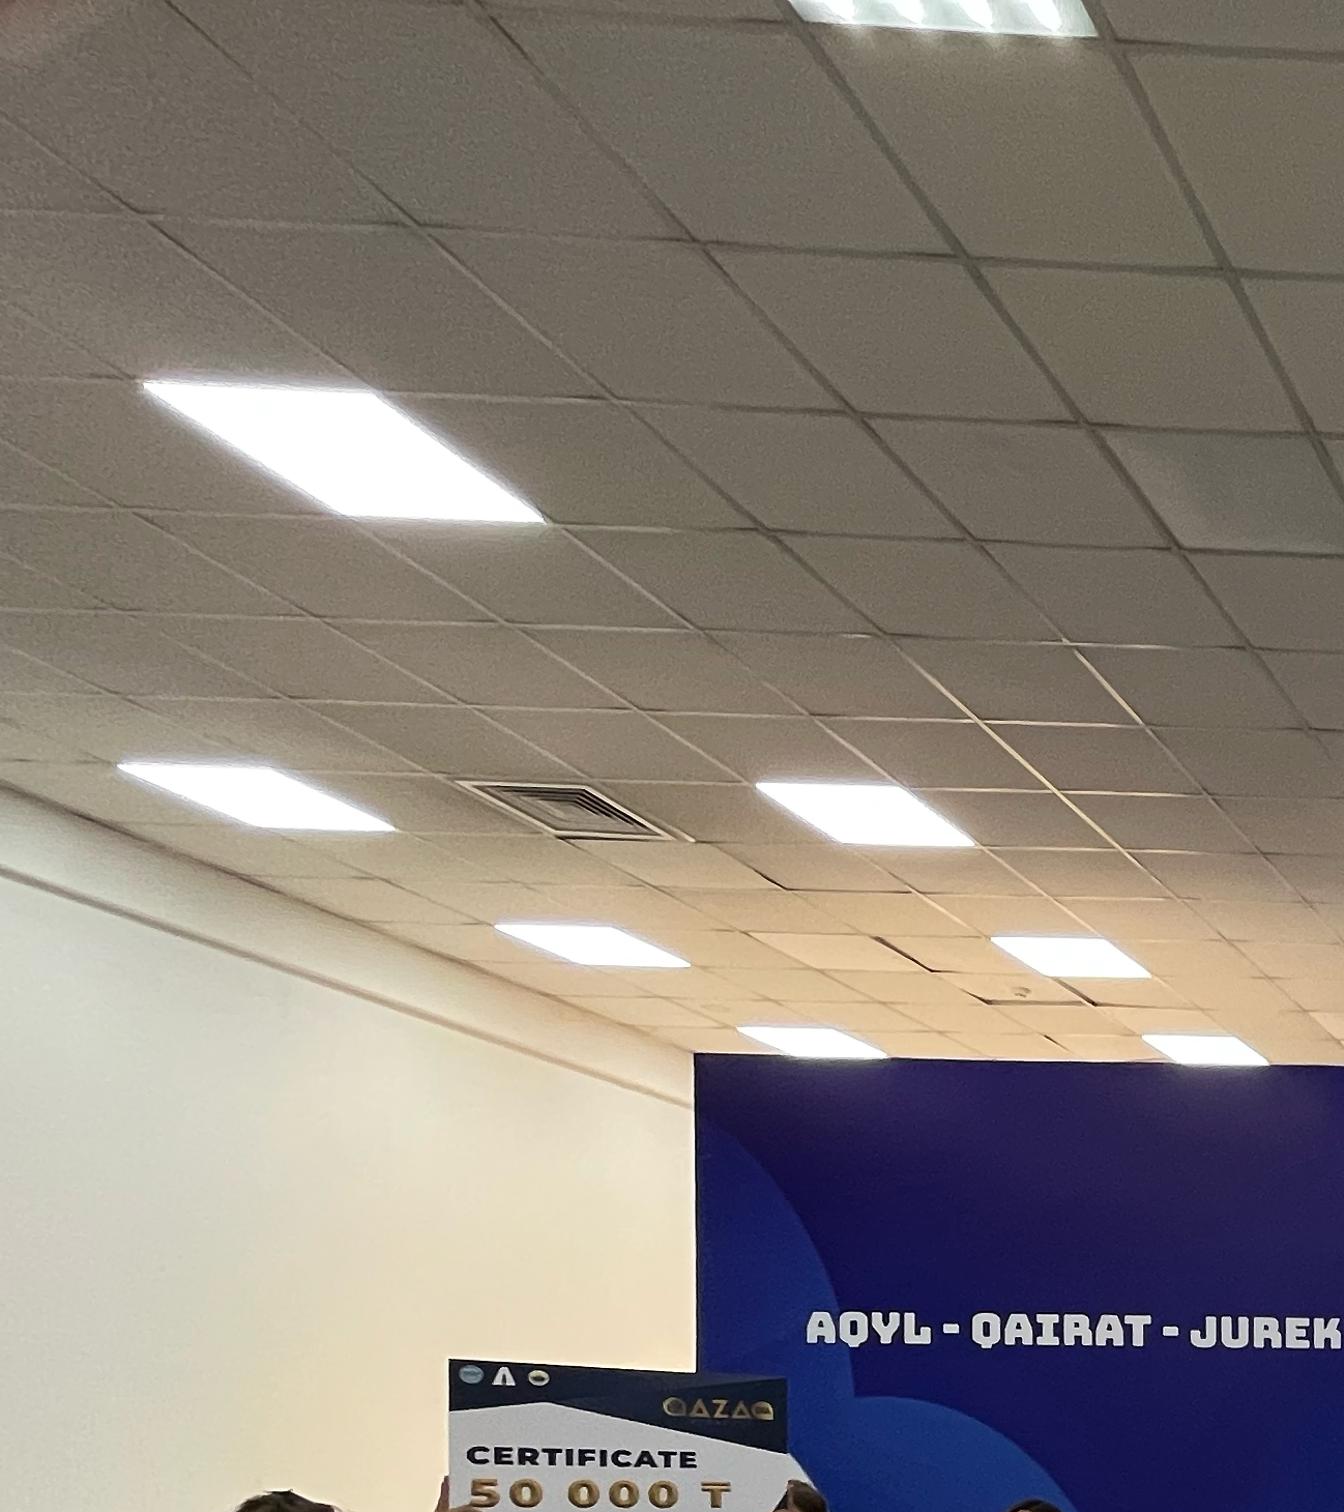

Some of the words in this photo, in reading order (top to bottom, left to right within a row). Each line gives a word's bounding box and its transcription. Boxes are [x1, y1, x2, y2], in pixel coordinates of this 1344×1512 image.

[805, 1310, 931, 1348] AQYL
[970, 1312, 1152, 1349] QAIRAT
[1189, 1315, 1343, 1349] JUREK
[466, 1446, 698, 1469] CERTIFICATE
[470, 1478, 544, 1509] 50
[567, 1479, 680, 1509] 000
